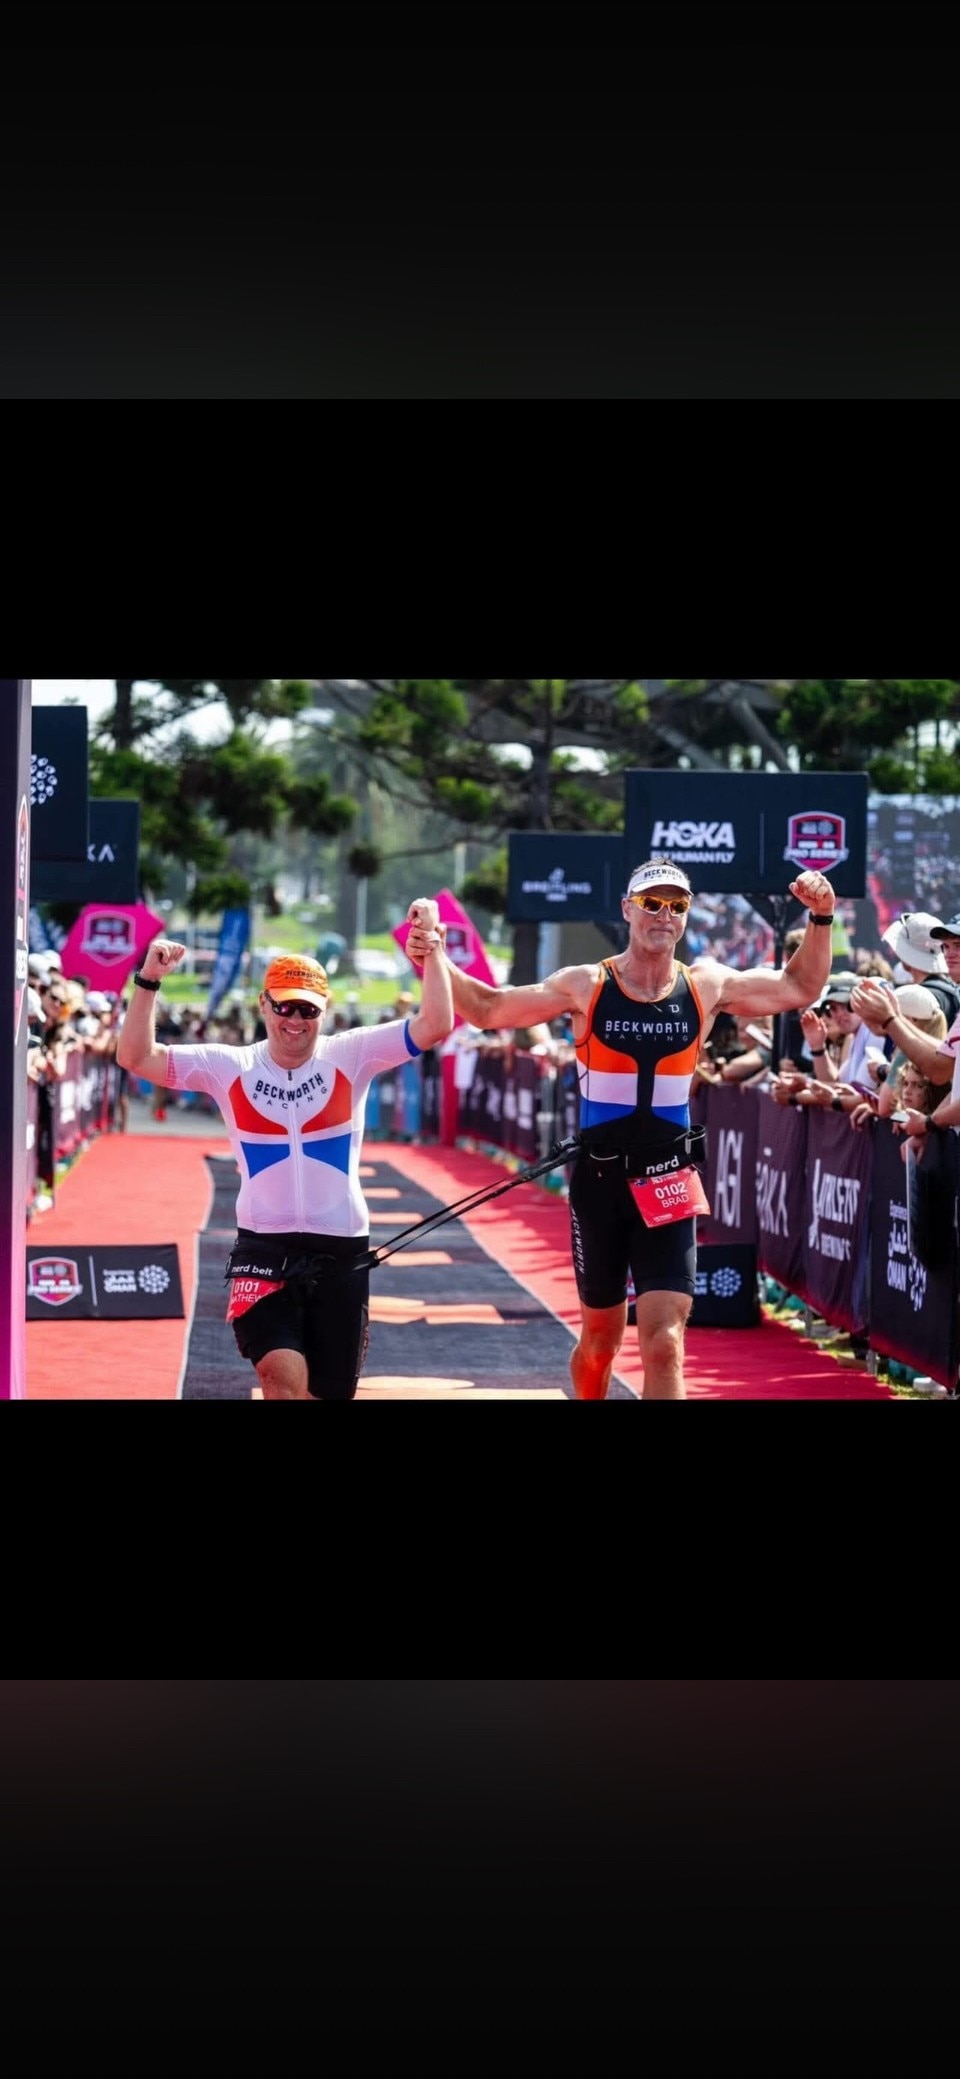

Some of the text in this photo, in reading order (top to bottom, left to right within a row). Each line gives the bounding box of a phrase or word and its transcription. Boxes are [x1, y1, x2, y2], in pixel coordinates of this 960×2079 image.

[651, 821, 736, 848] HOKA
[87, 844, 115, 862] KA
[605, 1020, 689, 1034] BECKWORTH
[605, 1034, 689, 1042] RACING
[255, 1073, 324, 1101] BECKWORTH
[252, 1086, 328, 1109] RACING
[646, 1155, 680, 1175] nerd
[655, 1182, 688, 1200] 0102
[661, 1194, 690, 1208] BRAD
[231, 1264, 273, 1276] nerd belt
[887, 1260, 906, 1292] OMAN
[234, 1281, 260, 1294] 0101
